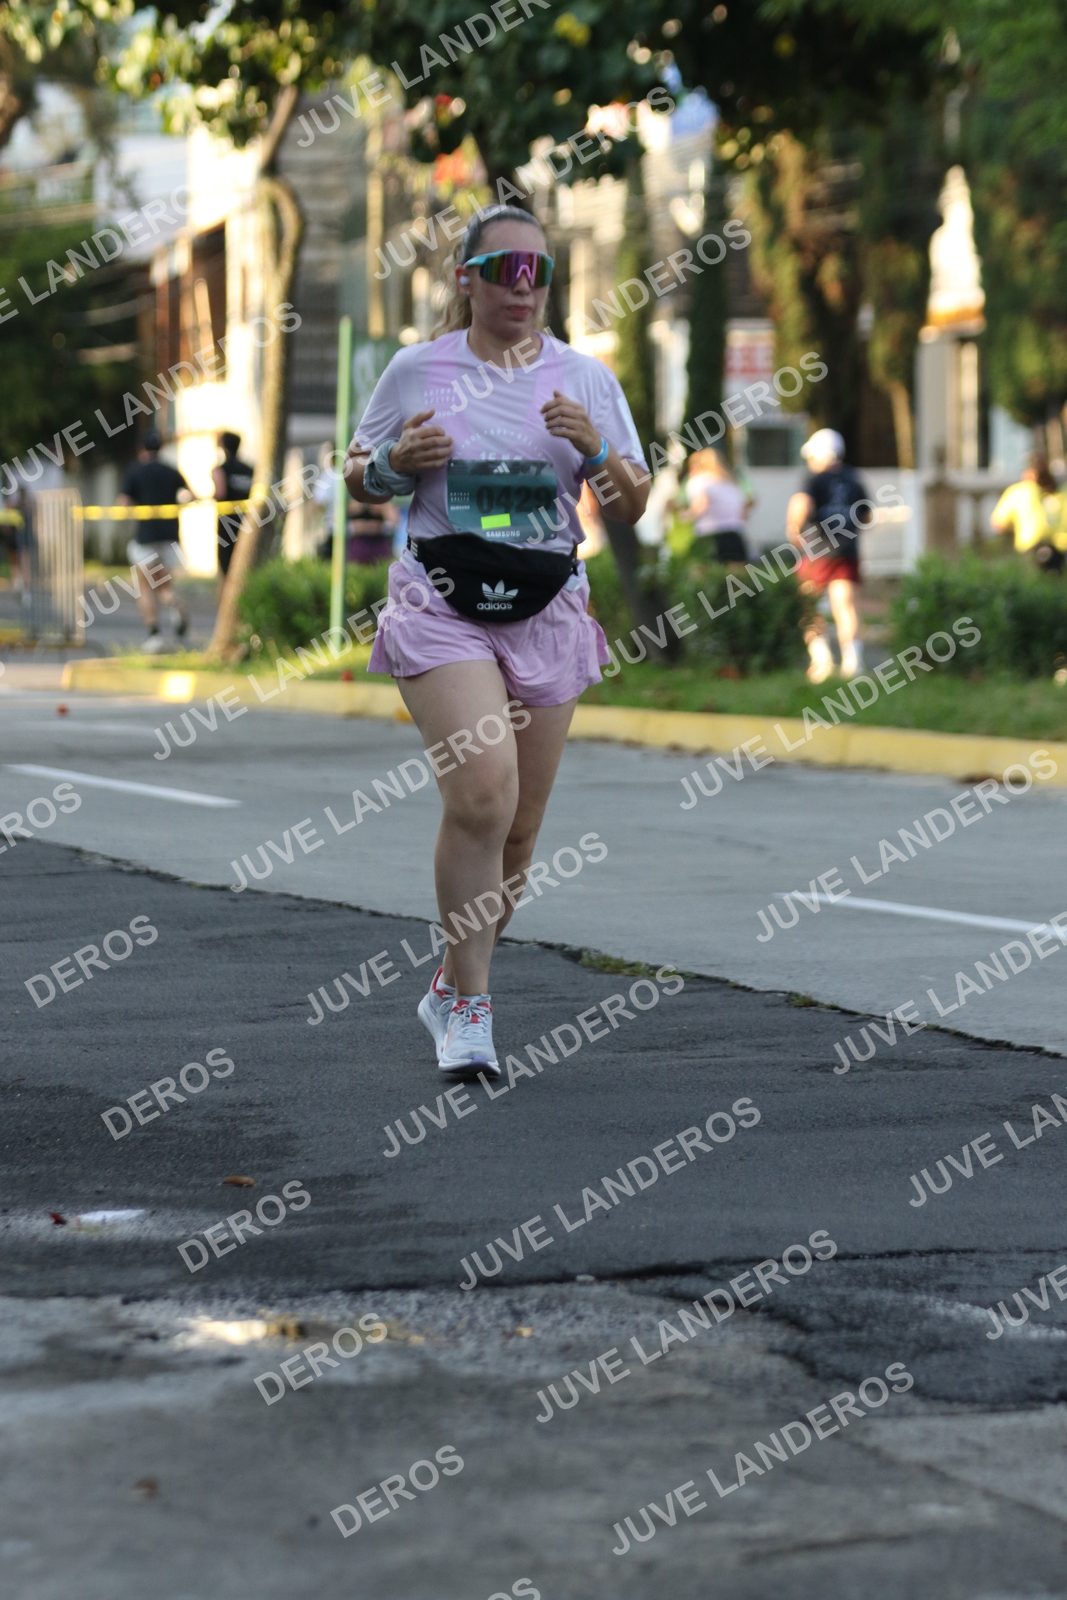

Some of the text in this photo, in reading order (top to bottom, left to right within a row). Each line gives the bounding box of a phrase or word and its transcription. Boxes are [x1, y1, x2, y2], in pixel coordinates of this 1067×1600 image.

[476, 486, 552, 514] 0429
[485, 530, 521, 538] SAMSUNG
[476, 601, 513, 610] adidas
